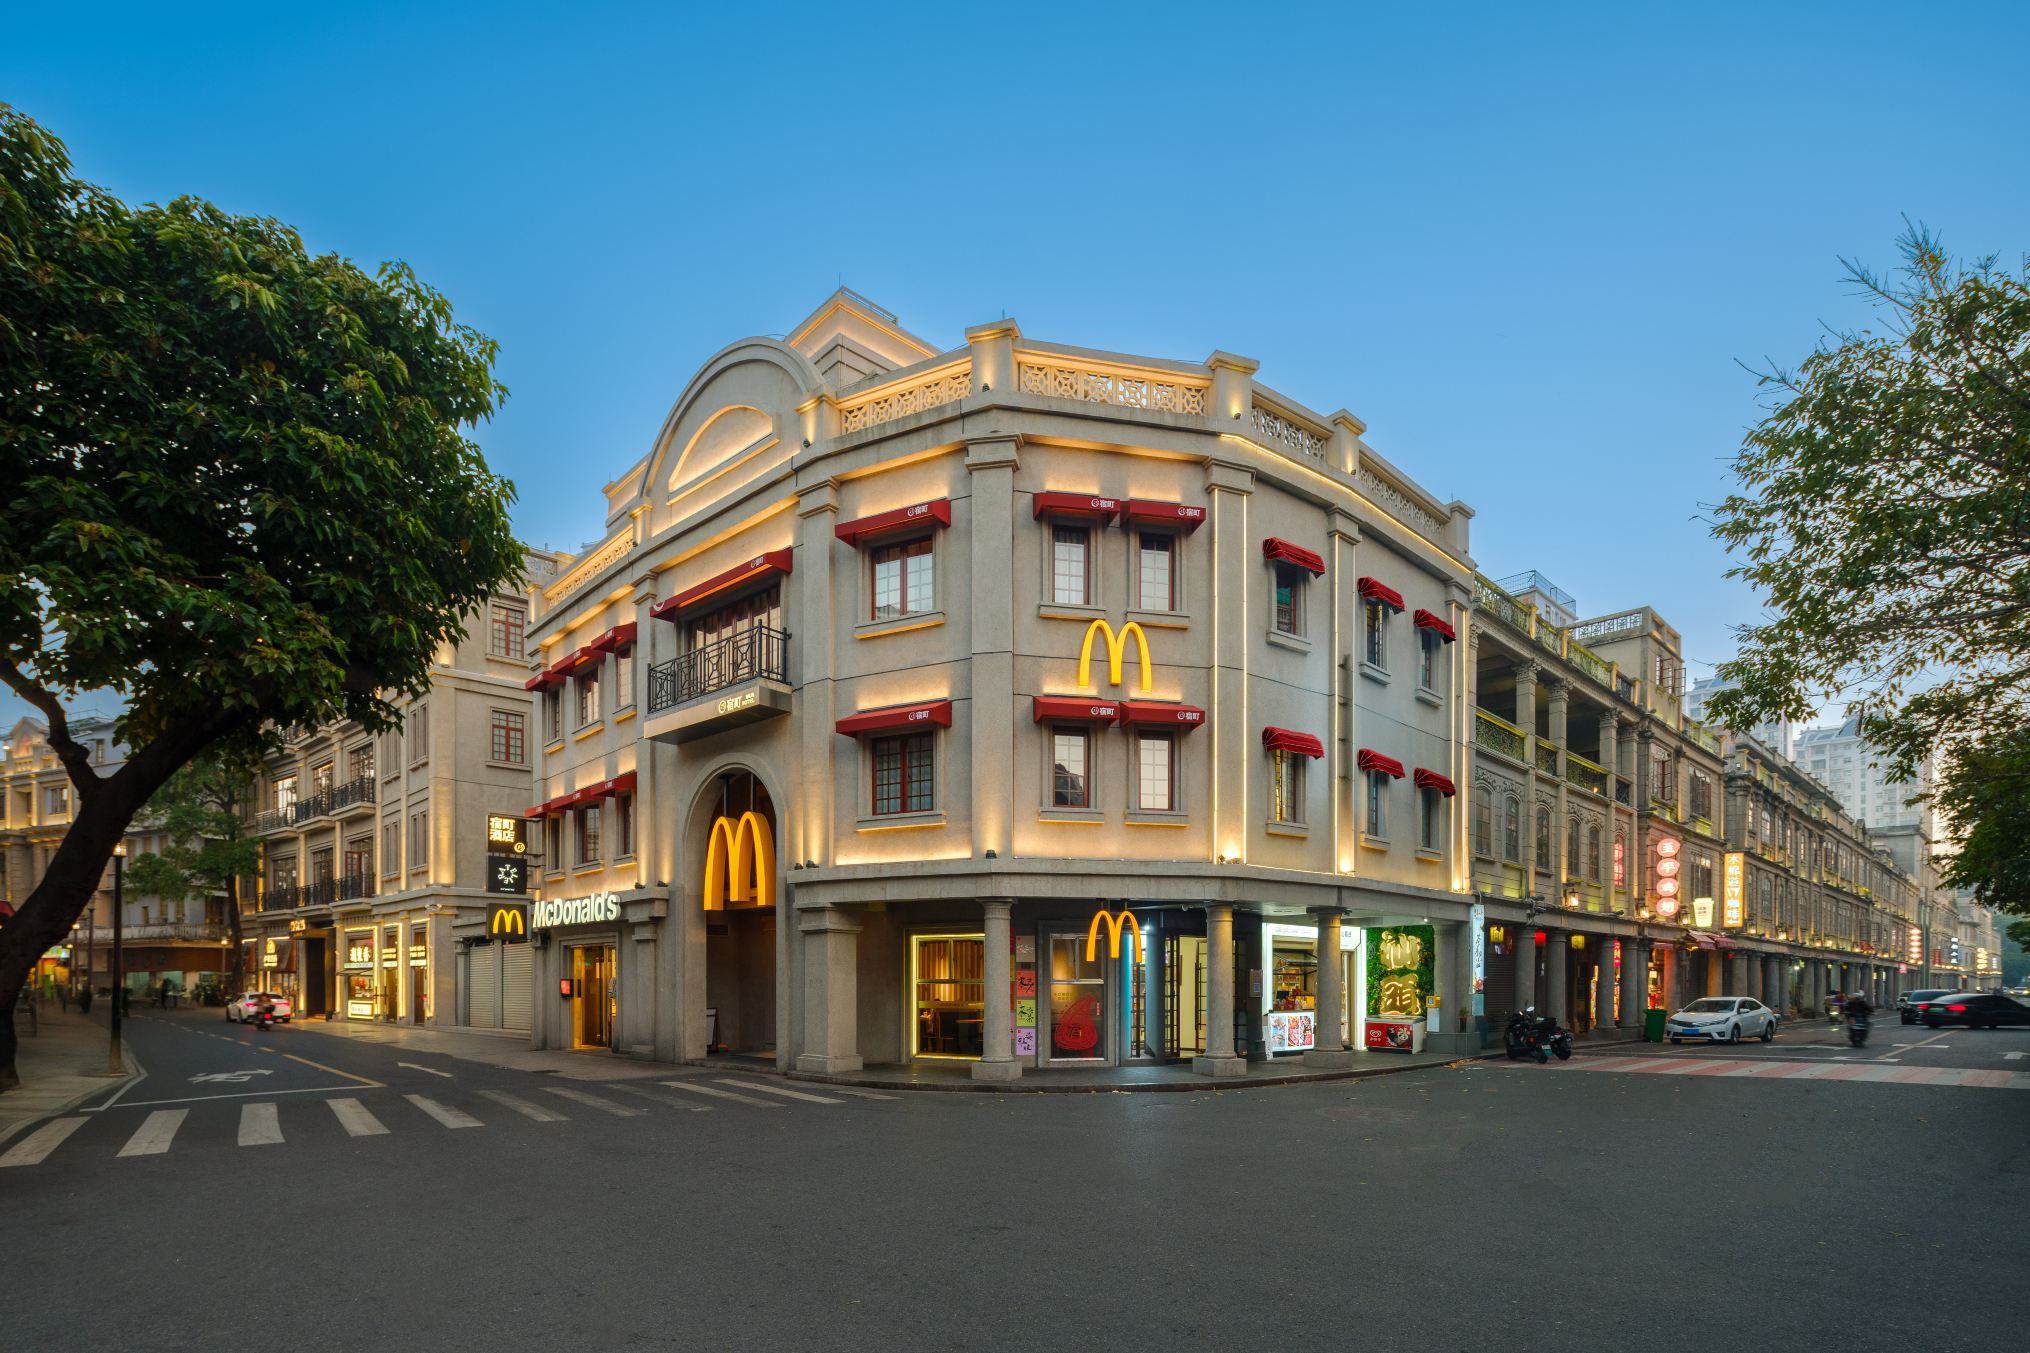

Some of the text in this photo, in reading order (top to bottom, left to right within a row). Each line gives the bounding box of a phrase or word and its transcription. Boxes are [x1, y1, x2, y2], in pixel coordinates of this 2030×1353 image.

[489, 817, 516, 830] 宿町
[489, 829, 515, 843] 酒店
[532, 891, 620, 928] McDonald's
